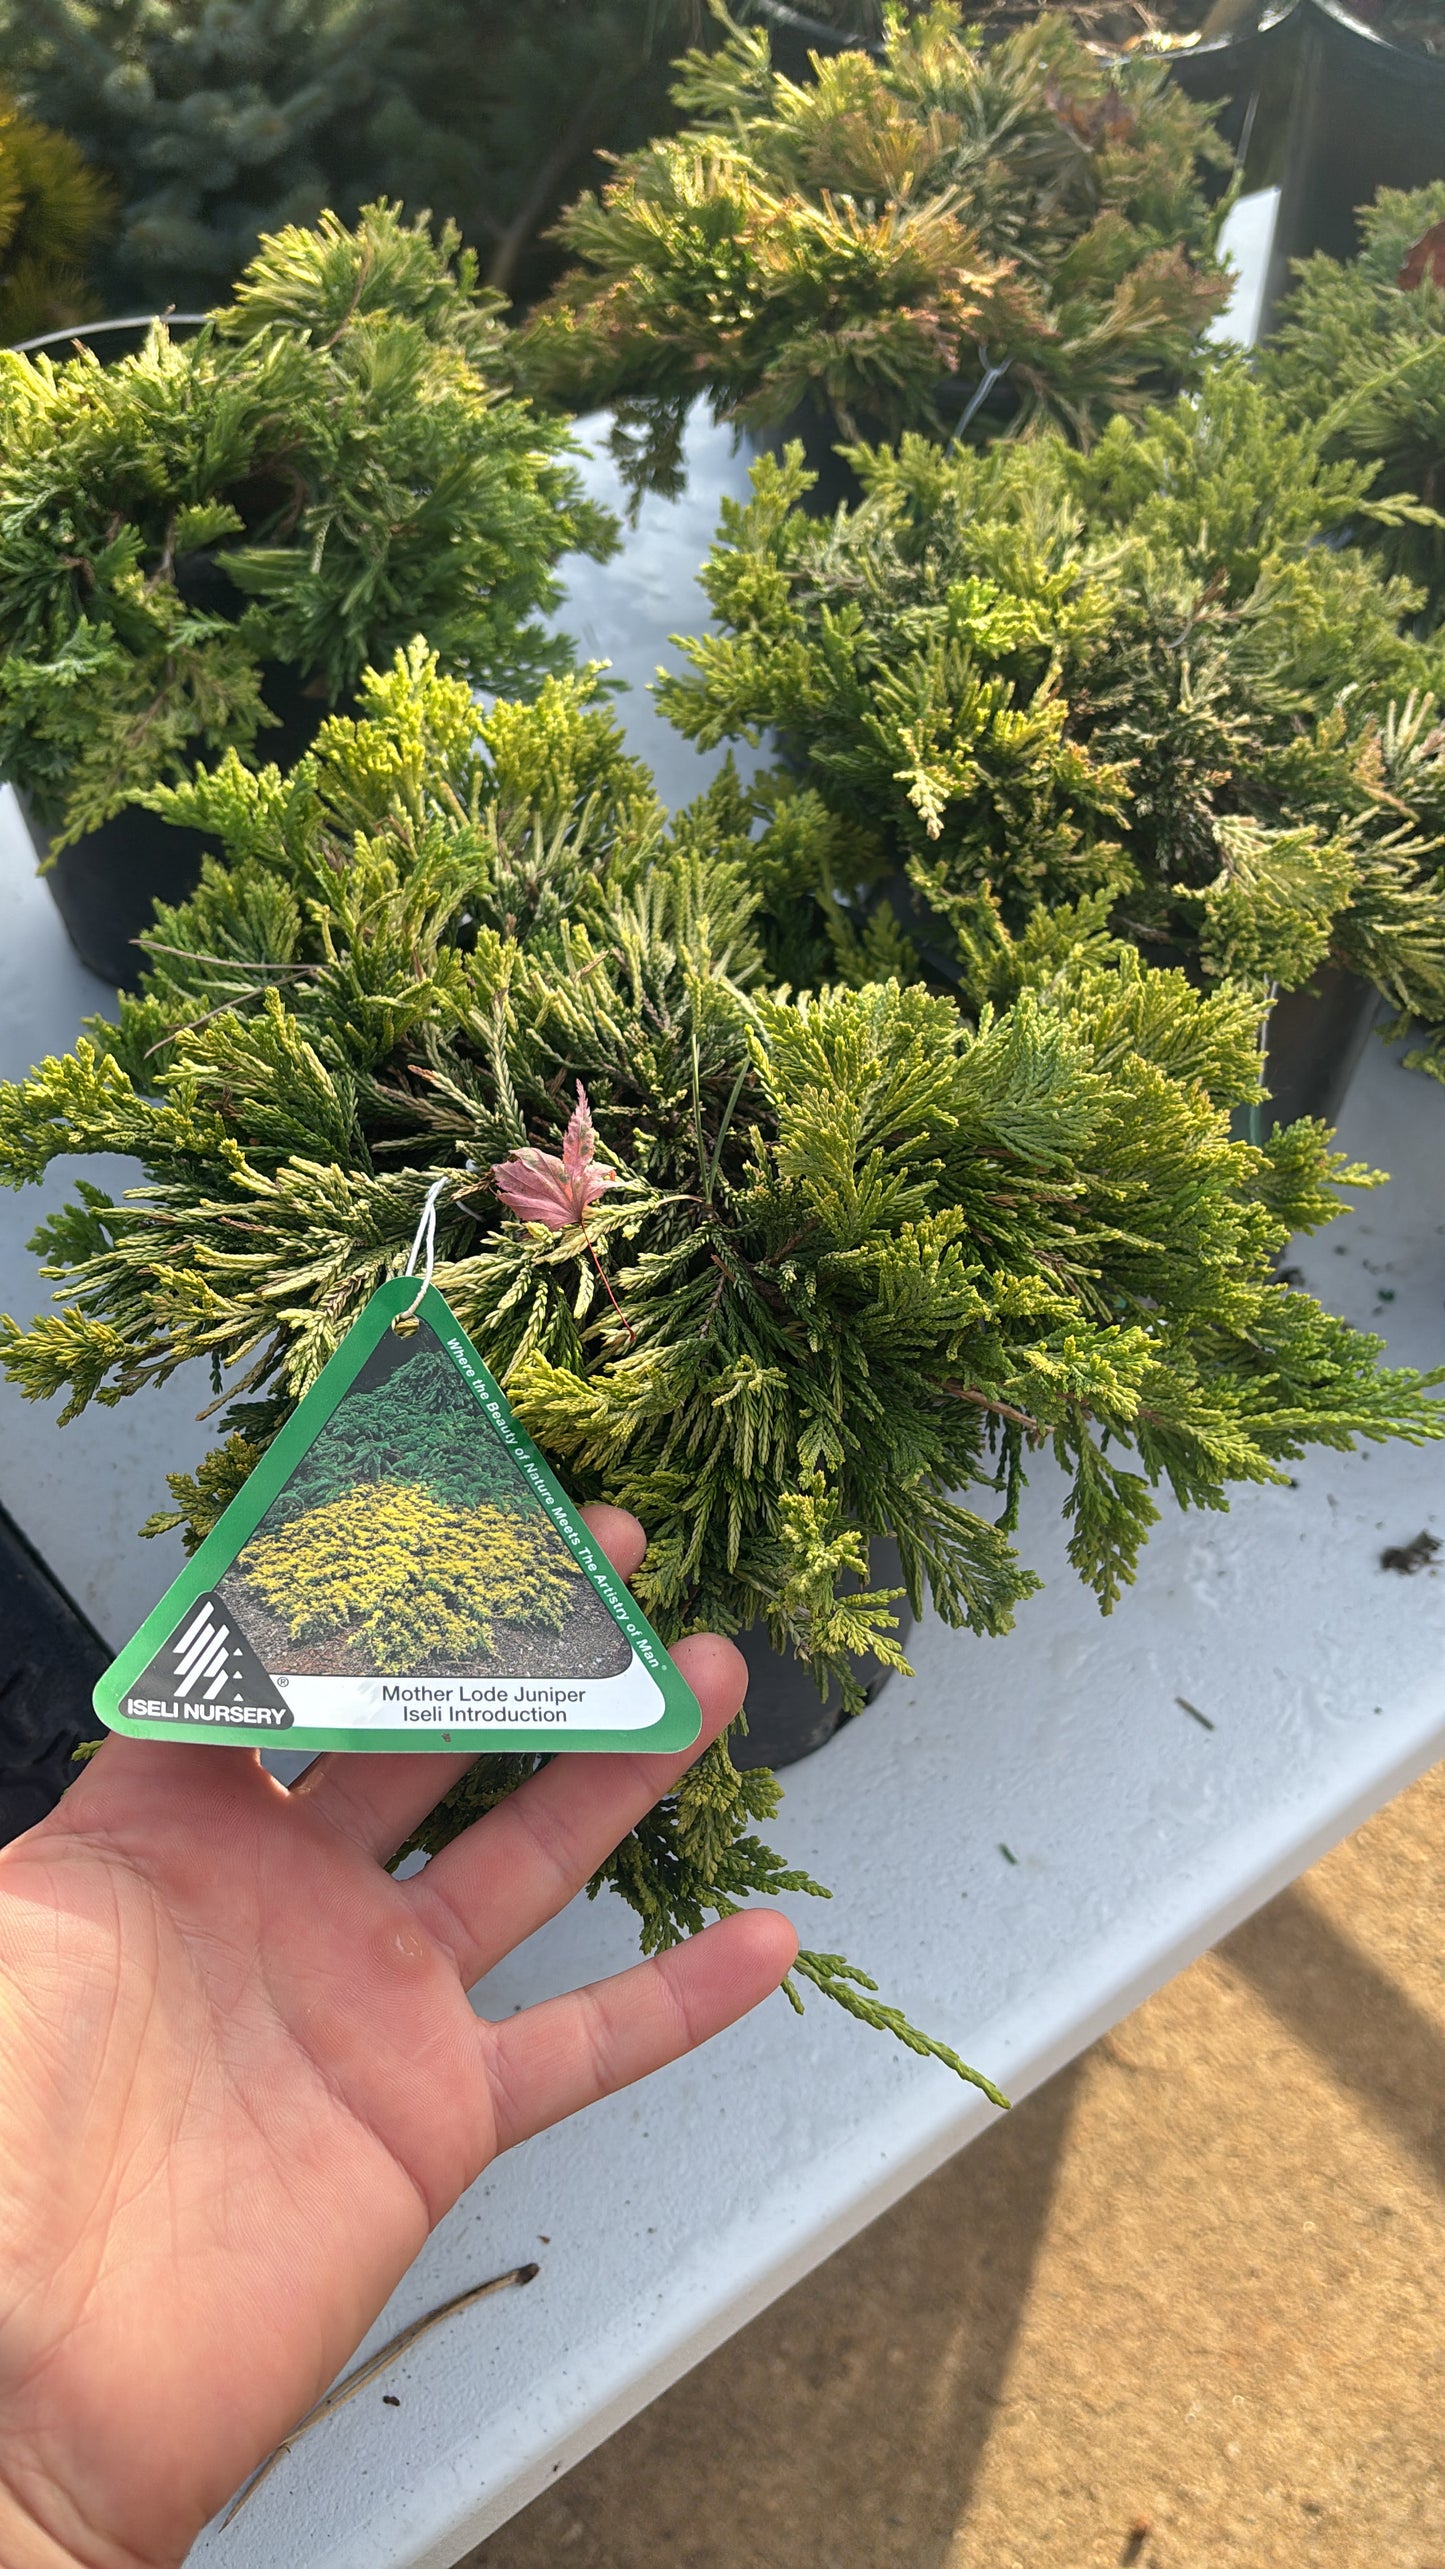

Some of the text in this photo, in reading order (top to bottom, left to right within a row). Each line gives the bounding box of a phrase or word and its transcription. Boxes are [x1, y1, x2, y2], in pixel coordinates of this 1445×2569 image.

[447, 1338, 659, 1668] Where the Beauty of Nature Meets The Artistry of Man
[382, 1685, 586, 1706] Mother Lode Juniper
[127, 1698, 286, 1725] ISELI NURSERY
[403, 1706, 567, 1722] Iseli Introduction
